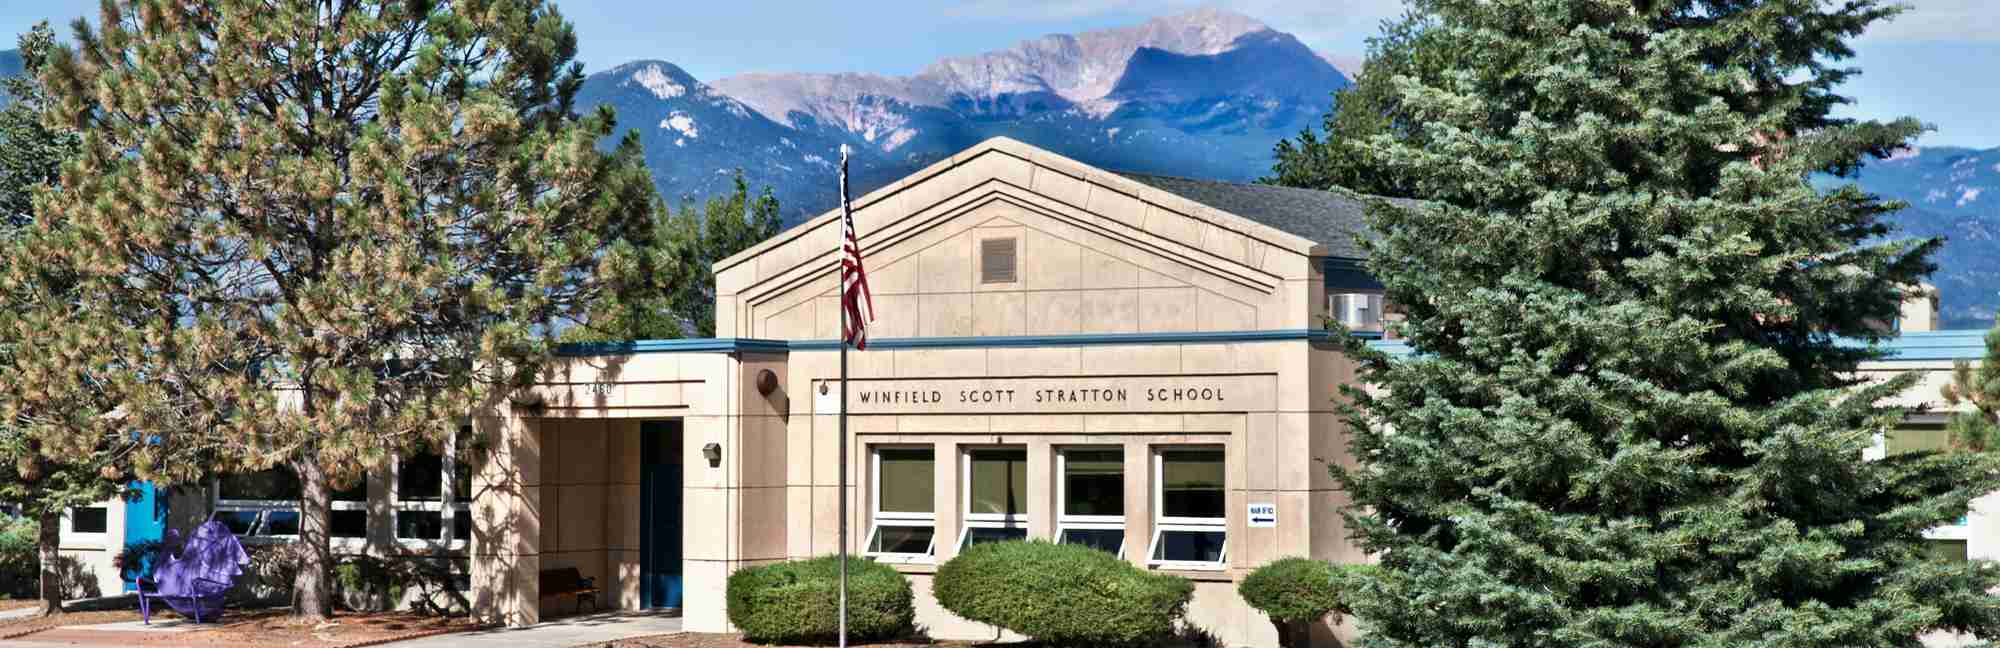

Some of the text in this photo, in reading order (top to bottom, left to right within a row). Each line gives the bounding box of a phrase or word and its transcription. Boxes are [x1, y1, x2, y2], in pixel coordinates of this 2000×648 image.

[859, 388, 1225, 404] WINFIELD SCOTT STRATTON SCHOOL
